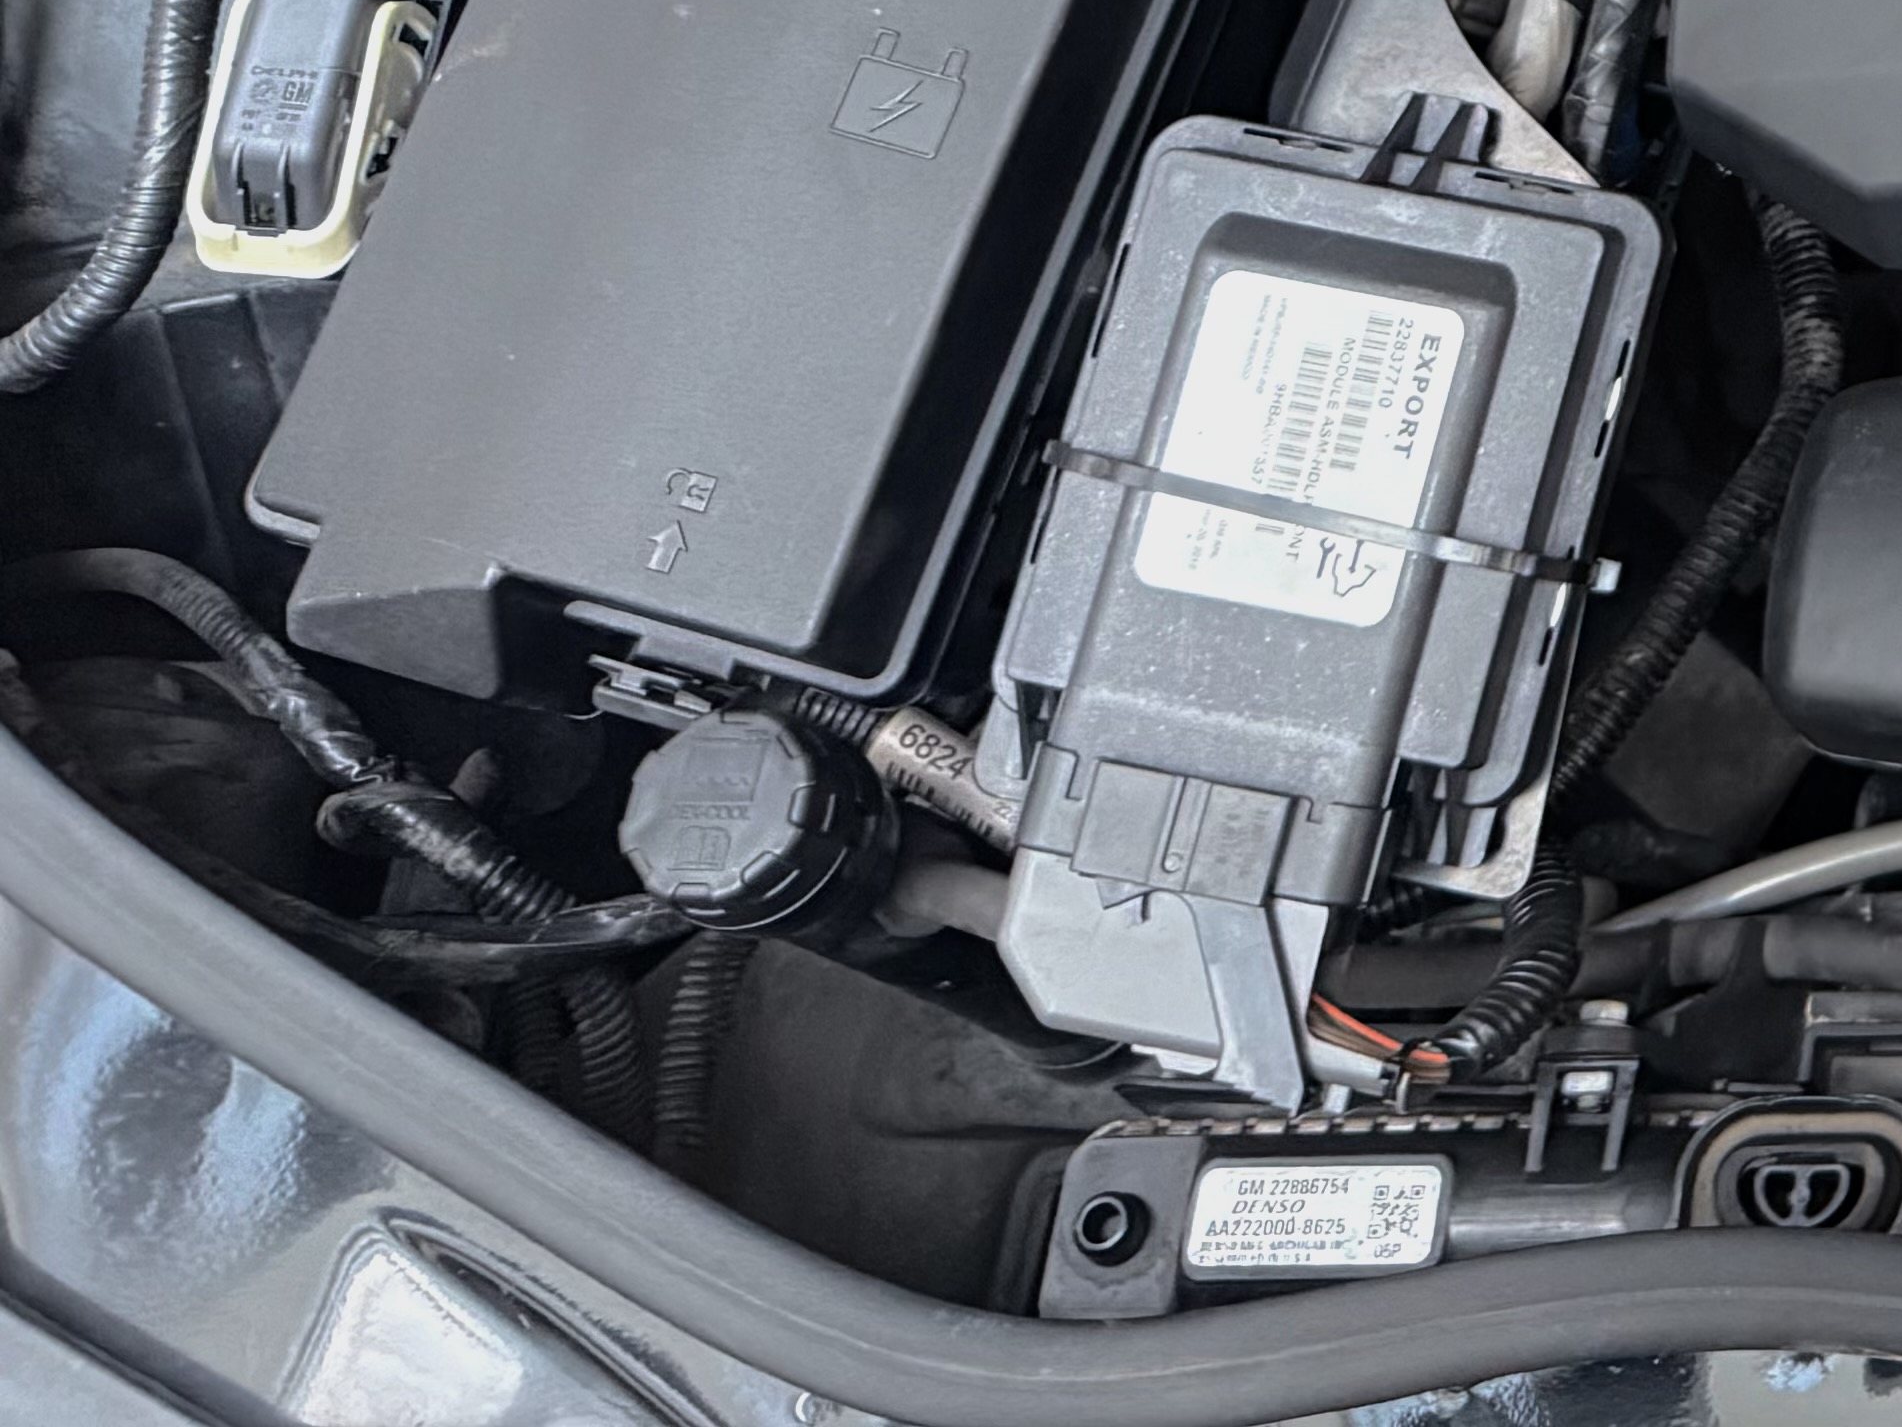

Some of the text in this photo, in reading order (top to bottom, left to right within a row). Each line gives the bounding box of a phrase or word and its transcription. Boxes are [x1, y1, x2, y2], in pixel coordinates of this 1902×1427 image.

[282, 80, 315, 104] GM
[1326, 338, 1356, 410] MODULE
[1378, 317, 1414, 408] 22837710
[1393, 333, 1442, 460] EXPORT
[899, 723, 974, 780] 6824
[1231, 1199, 1306, 1214] DENSO
[1237, 1178, 1350, 1196] GM 22886754
